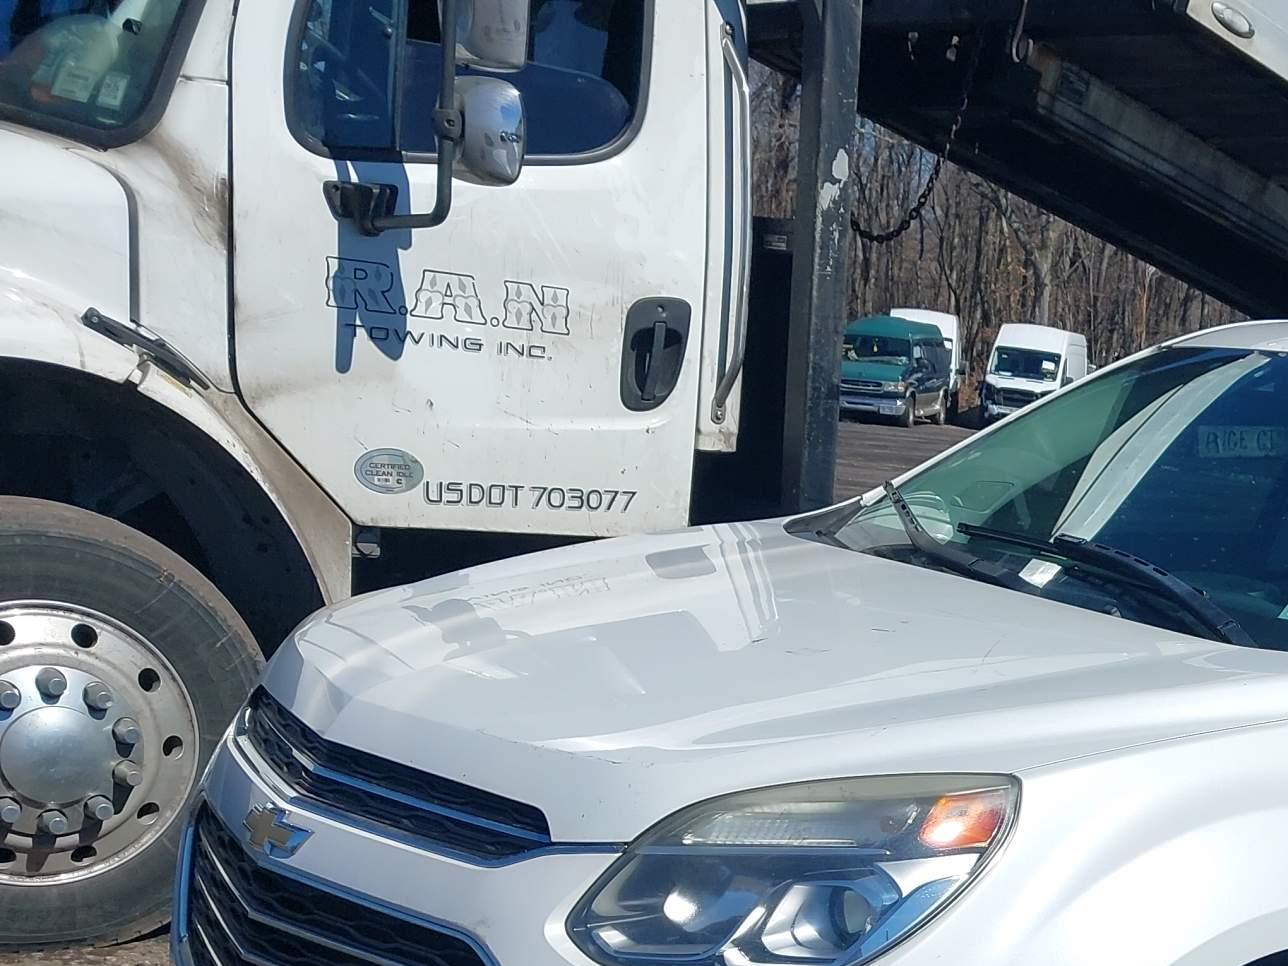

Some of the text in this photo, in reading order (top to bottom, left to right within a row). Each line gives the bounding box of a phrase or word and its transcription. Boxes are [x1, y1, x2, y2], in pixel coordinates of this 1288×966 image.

[325, 256, 570, 336] R.A.N
[345, 323, 553, 361] TOWING INC.
[424, 480, 637, 514] USDOT 703077
